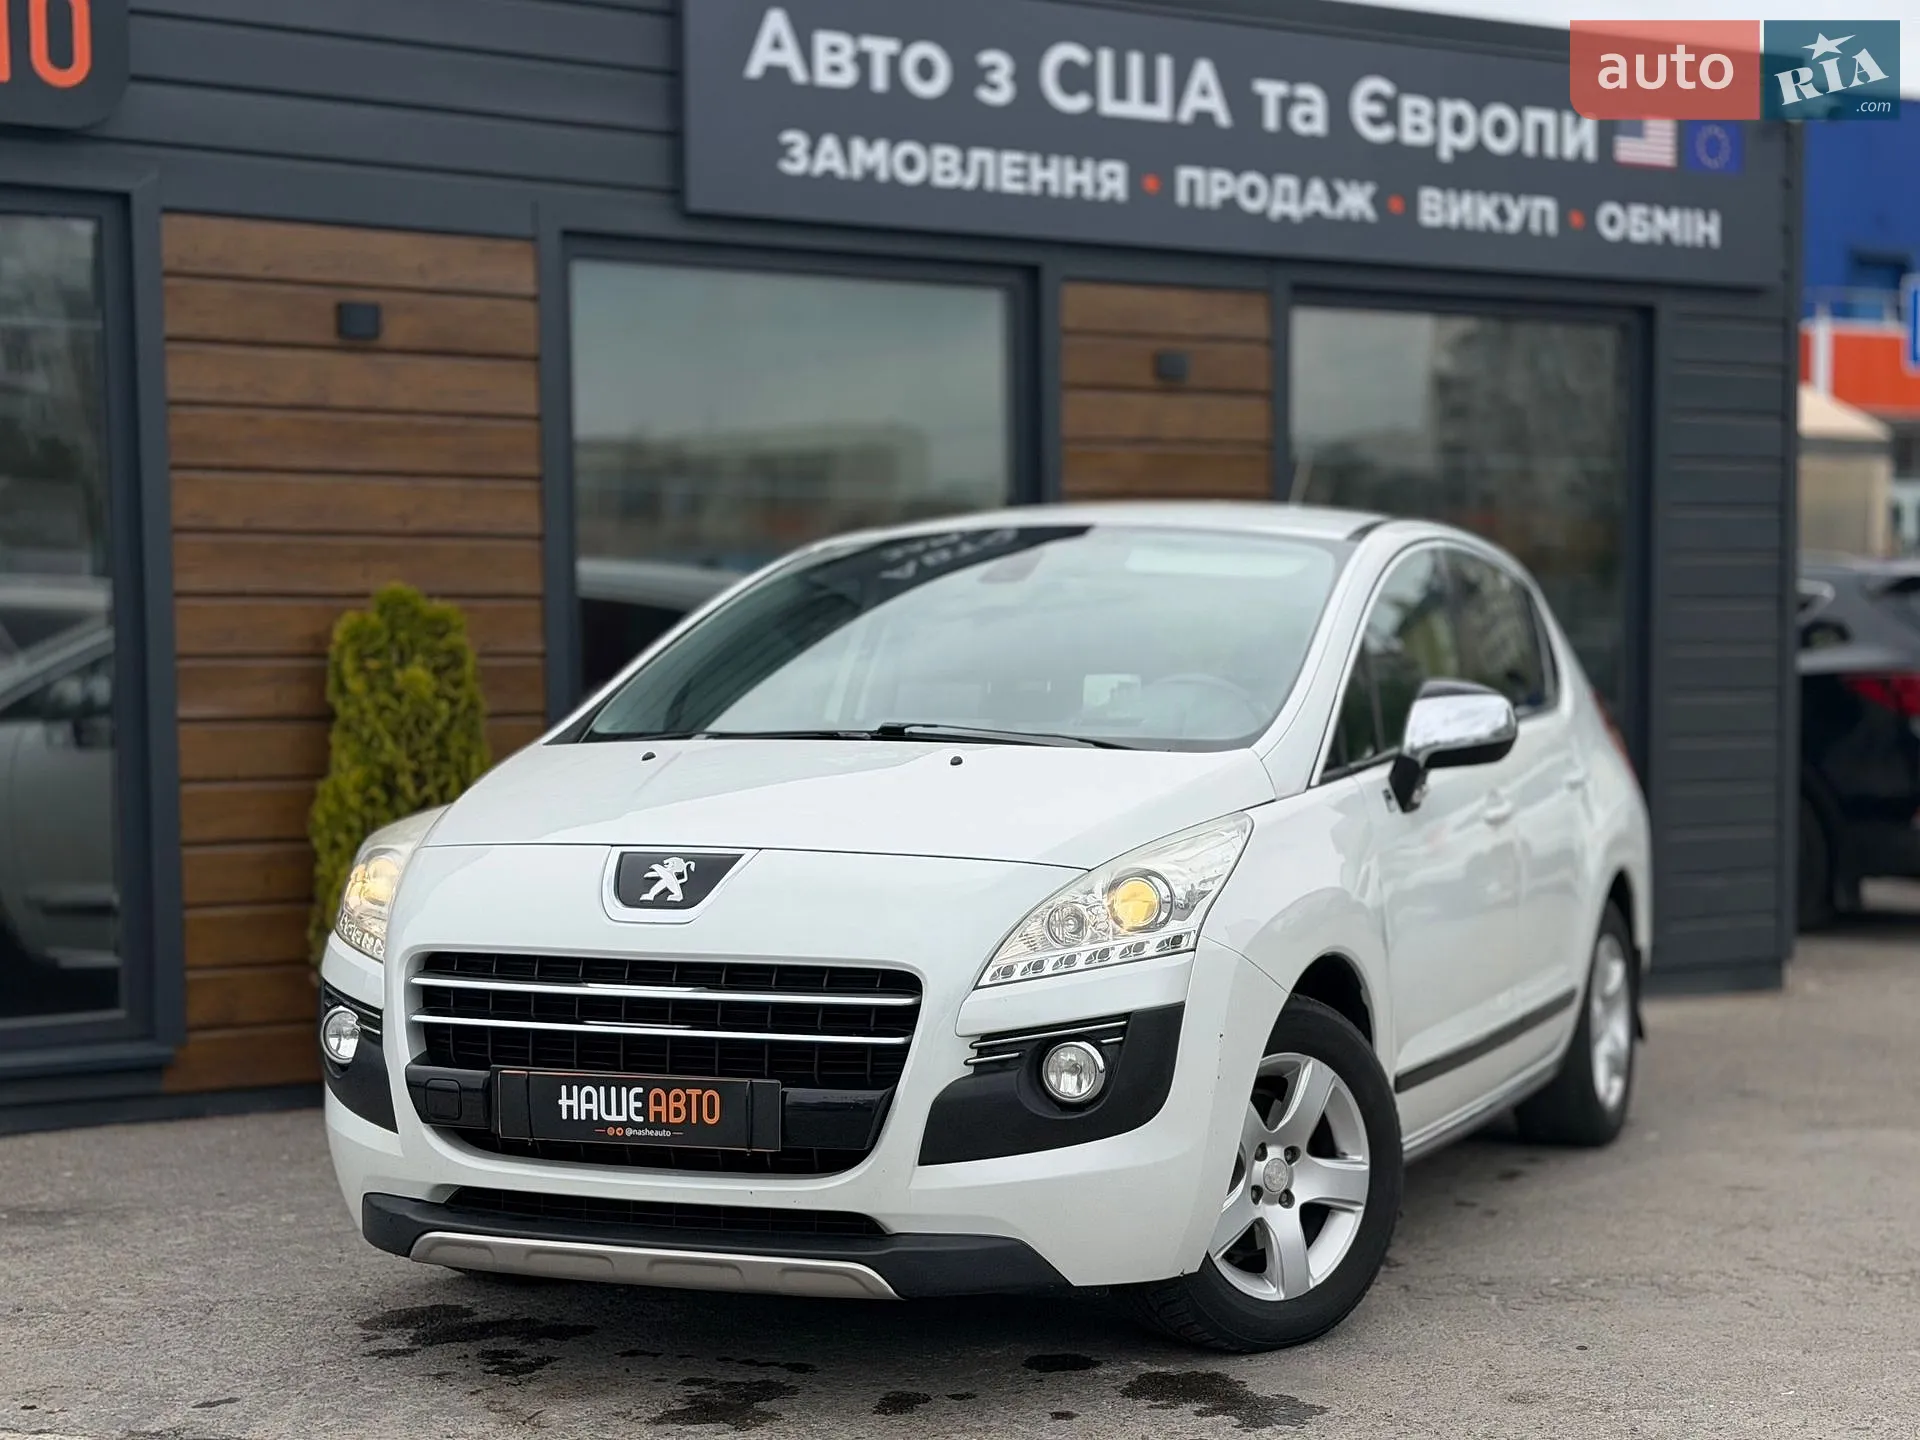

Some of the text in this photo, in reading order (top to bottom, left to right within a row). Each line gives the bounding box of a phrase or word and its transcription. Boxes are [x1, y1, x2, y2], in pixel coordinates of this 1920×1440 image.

[744, 7, 1599, 162] Авто з США та Європи
[778, 130, 1722, 249] ЗАМОВЛЕННЯ ПРОДАЖ ВИКУП ОБМІН
[625, 1127, 671, 1138] @nasheauto
